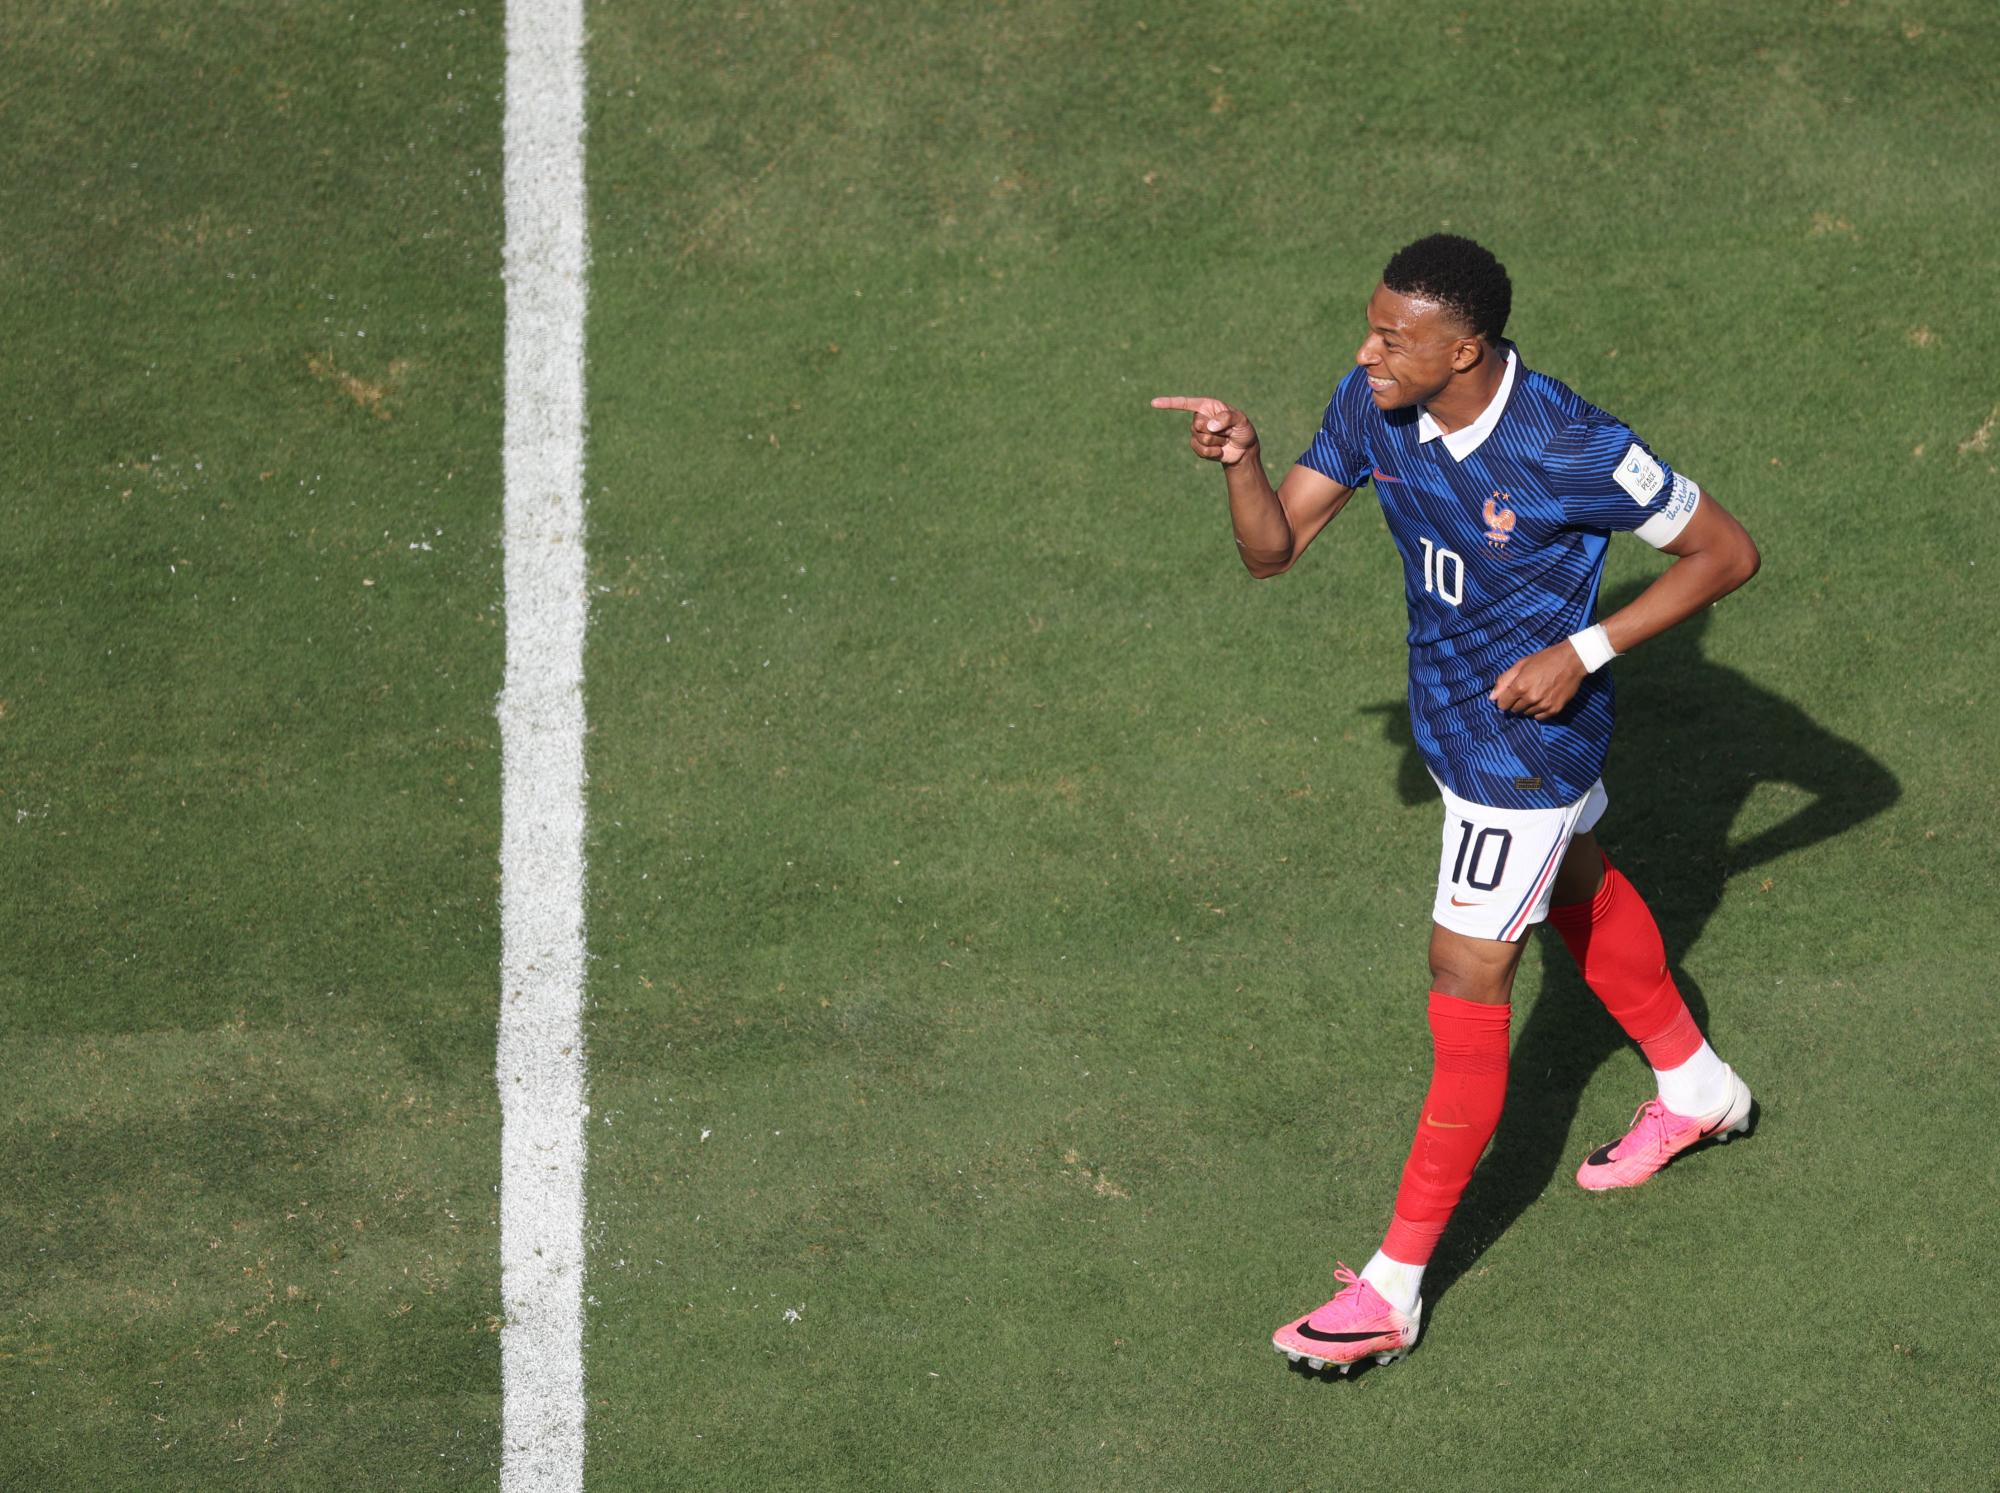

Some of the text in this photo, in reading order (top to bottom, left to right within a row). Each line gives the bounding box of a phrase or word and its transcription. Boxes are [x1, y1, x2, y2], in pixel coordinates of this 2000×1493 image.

[1641, 471, 1657, 491] PEACE
[1420, 536, 1464, 607] 10
[1451, 819, 1513, 891] 10
